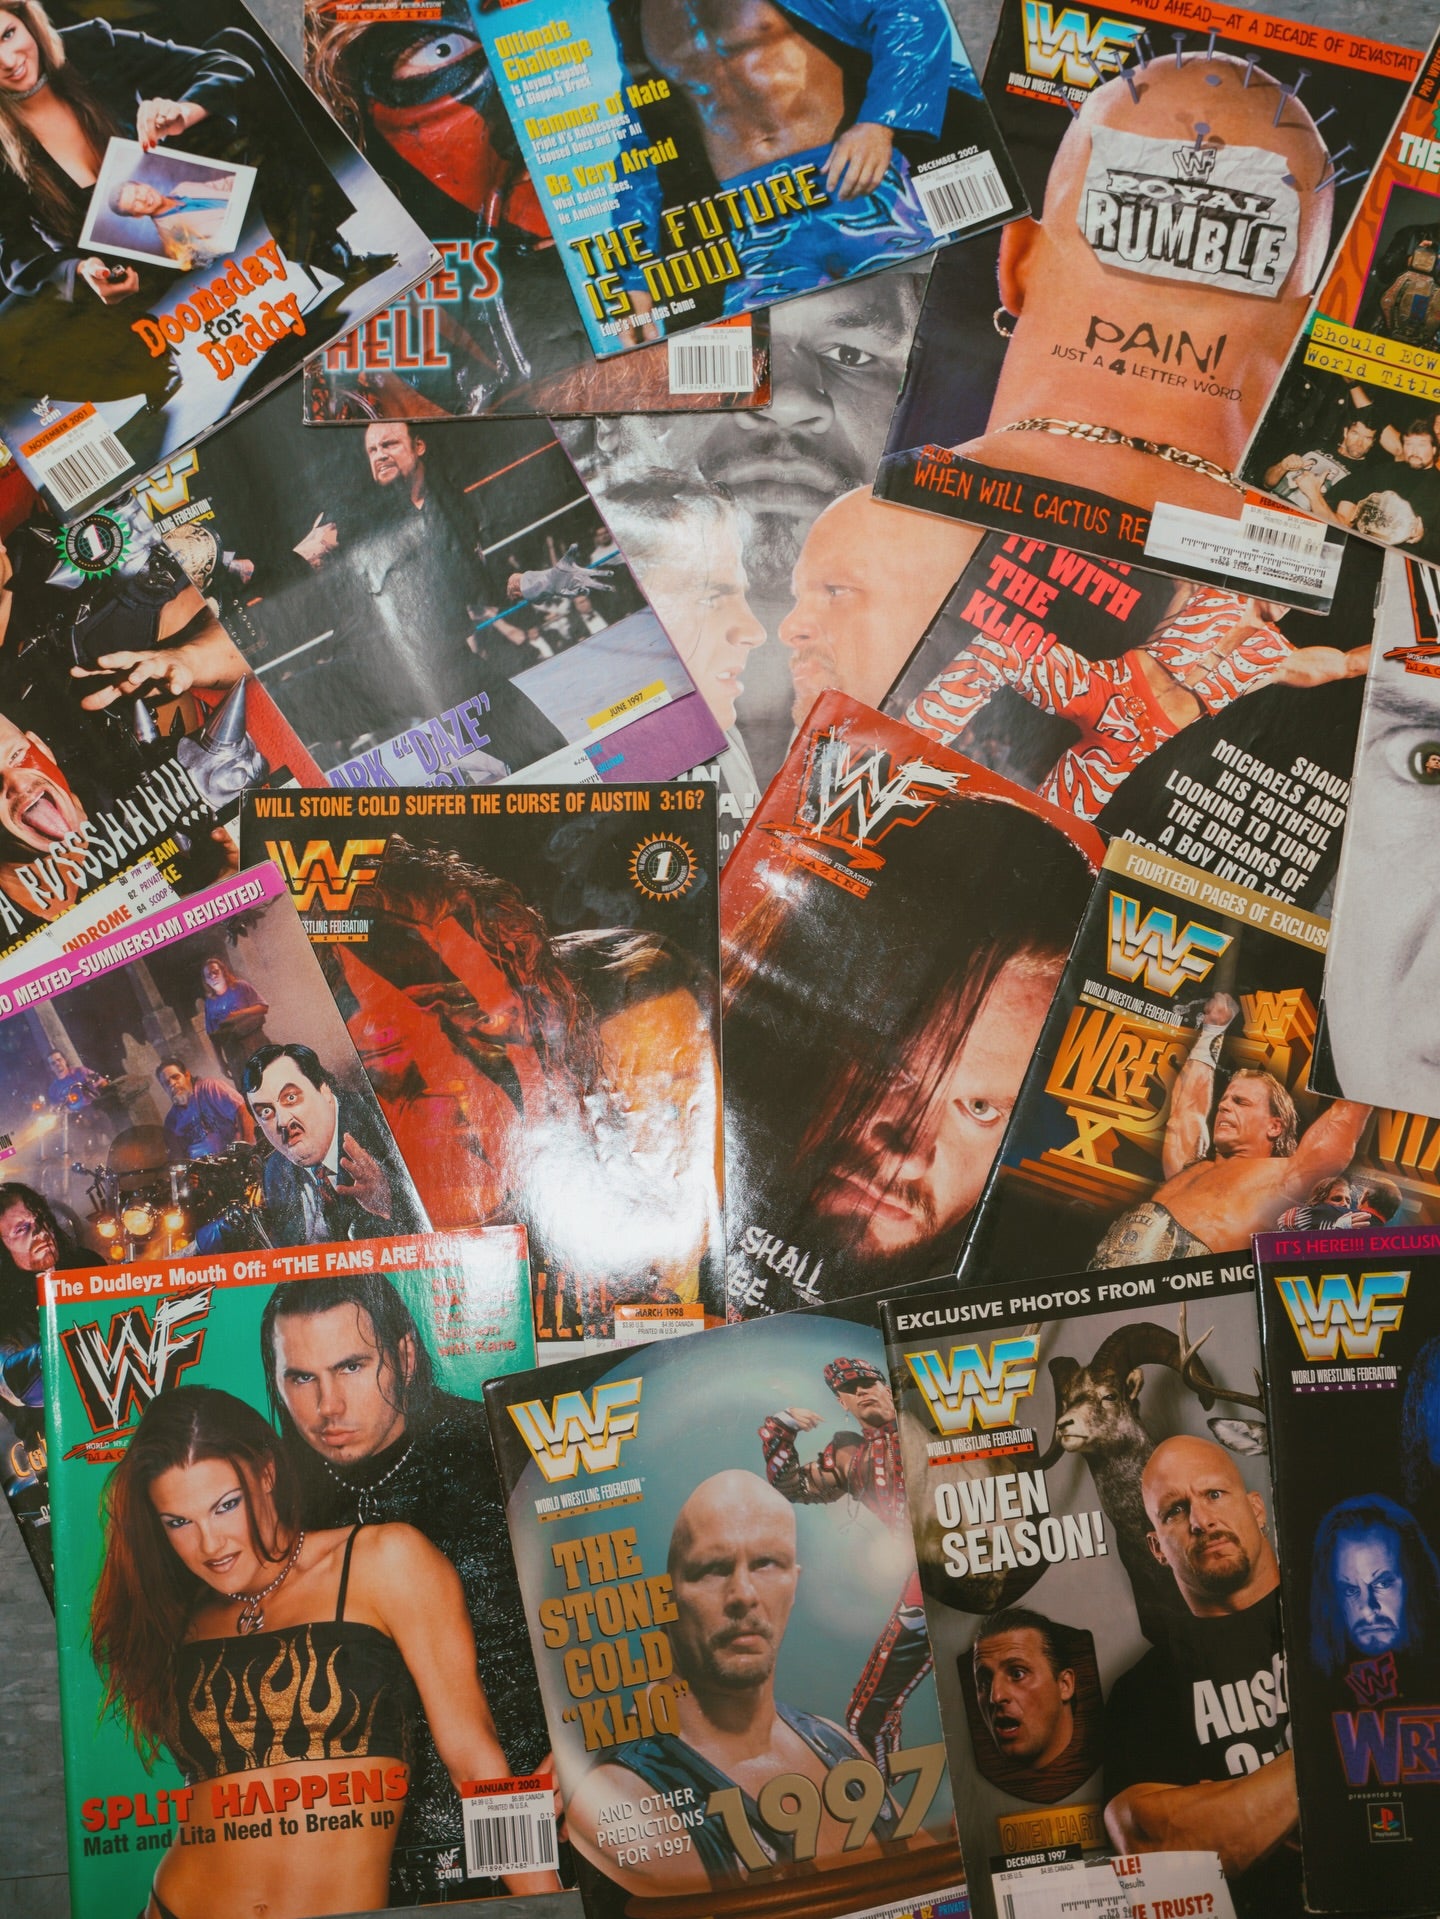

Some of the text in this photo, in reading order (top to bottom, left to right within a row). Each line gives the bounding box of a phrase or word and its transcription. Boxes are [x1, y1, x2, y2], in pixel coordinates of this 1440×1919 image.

[494, 20, 571, 58] Ultimate
[503, 39, 592, 81] Challenge
[1248, 18, 1345, 54] A DECADE OF
[1008, 71, 1030, 88] WORLD
[1419, 78, 1435, 97] PRO
[524, 78, 671, 140] Hammer of Hate
[544, 137, 679, 196] Be Very Afraid
[917, 144, 979, 174] DECEMBER 2002
[1398, 131, 1440, 174] THE
[552, 194, 577, 212] What
[567, 163, 828, 276] THE FUTURE
[1106, 173, 1272, 221] ROYAL
[1084, 188, 1287, 285] RUMBLE
[132, 239, 289, 358] Doomsday
[584, 237, 742, 320] IS NOW
[197, 292, 307, 382] Daddy
[202, 306, 246, 344] for
[600, 297, 697, 338] Edge's Time Has Come
[1085, 315, 1228, 380] PAIN!
[1313, 323, 1438, 371] Should ECW
[1051, 343, 1243, 402] JUST A 4 LETTER WORD.
[1307, 346, 1440, 399] World Title
[28, 422, 69, 452] NOVEMBER
[173, 499, 212, 527] FEDERATION
[914, 460, 1110, 536] WHEN WILL CACTUS
[83, 524, 107, 562] 1
[986, 553, 1060, 619] THE
[1048, 547, 1142, 622] WITH
[959, 589, 1058, 665] KLIQ!
[609, 692, 644, 717] JUNE 1997
[255, 789, 705, 818] WILL STONE COLD SUFFER THE CURSE OF AUSTIN 3:16?
[1211, 738, 1346, 828] MICHAELS AND
[1165, 769, 1321, 873] LOOKING TO TURN
[1215, 769, 1331, 851] HIS FAITHFUL
[652, 850, 672, 882] 1
[1158, 825, 1175, 846] A
[1175, 833, 1217, 868] BOY
[1213, 856, 1259, 890] INTO
[1166, 798, 1204, 833] THE
[1202, 820, 1281, 878] DREAMS
[1281, 868, 1309, 892] OF
[139, 871, 163, 893] PRIVATE
[183, 879, 266, 929] REVISITED!
[1126, 854, 1270, 923] FOURTEEN PAGES OF
[329, 919, 369, 934] FEDERATION
[1107, 890, 1235, 998] WWF
[1083, 979, 1183, 1029] WORLD WRESTLING FEDERATION
[50, 1243, 417, 1298] The Dudleyz Mouth Off: FANS ARE
[739, 1226, 824, 1296] SHALL
[1275, 1237, 1365, 1256] IT'S HERE!!!
[635, 1306, 684, 1318] MARCH 1998
[896, 1264, 1214, 1331] EXCLUSIVE PHOTOS FROM "ONE
[1273, 1271, 1411, 1362] WWF
[438, 1339, 517, 1356] with Kane
[904, 1334, 1041, 1437] WWF
[1291, 1365, 1397, 1384] WORLD WRESTLING FEDERATION
[506, 1377, 643, 1483] WWF
[926, 1427, 1033, 1457] WORLD WRESTLING FEDERATION
[534, 1477, 642, 1514] WORLD WRESTLING FEDERATION
[934, 1470, 1051, 1530] OWEN
[552, 1527, 643, 1590] THE
[941, 1511, 1108, 1579] SEASON!
[538, 1574, 680, 1649] STONE
[563, 1631, 673, 1699] COLD
[562, 1680, 690, 1751] "KLIQ"
[212, 1766, 409, 1819] HAPPENS
[474, 1778, 541, 1795] JANUARY 2002
[597, 1787, 695, 1825] AND OTHER
[704, 1742, 946, 1872] 1997
[83, 1808, 396, 1857] Matt and Lita Need to Break up
[596, 1808, 705, 1848] PREDICTIONS
[616, 1834, 692, 1868] FOR 1997
[1003, 1817, 1053, 1851] OWEN
[1006, 1850, 1067, 1869] DECEMBER 1997
[1120, 1878, 1145, 1889] Results
[938, 1901, 966, 1916] PRIVATE
[1152, 1893, 1214, 1919] TRUST?
